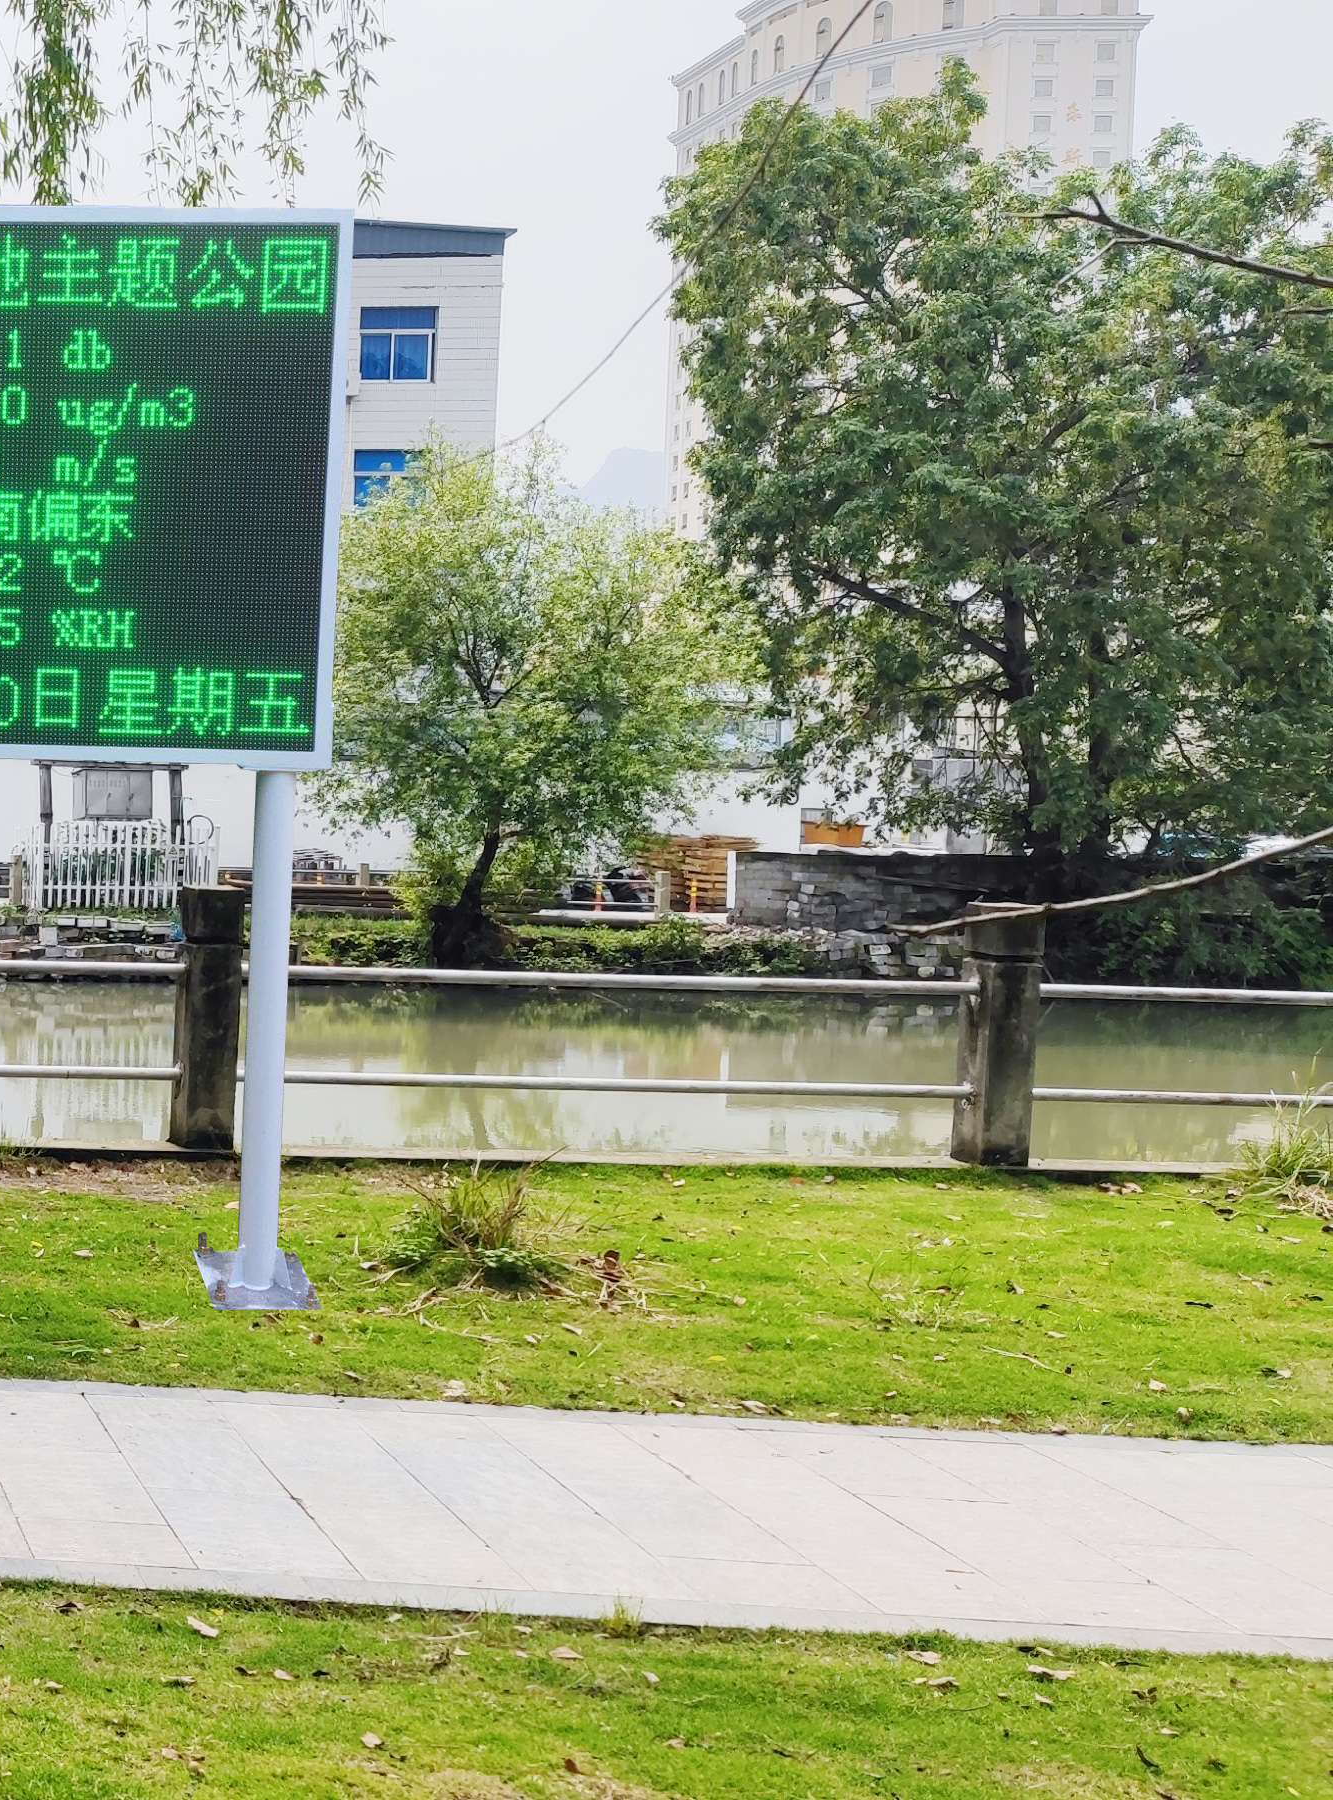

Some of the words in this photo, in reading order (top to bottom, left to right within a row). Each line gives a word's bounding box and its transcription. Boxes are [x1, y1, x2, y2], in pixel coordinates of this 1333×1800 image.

[61, 326, 112, 371] db
[56, 380, 195, 436] ug/m3
[54, 438, 137, 487] m/s
[50, 608, 136, 649] %RH
